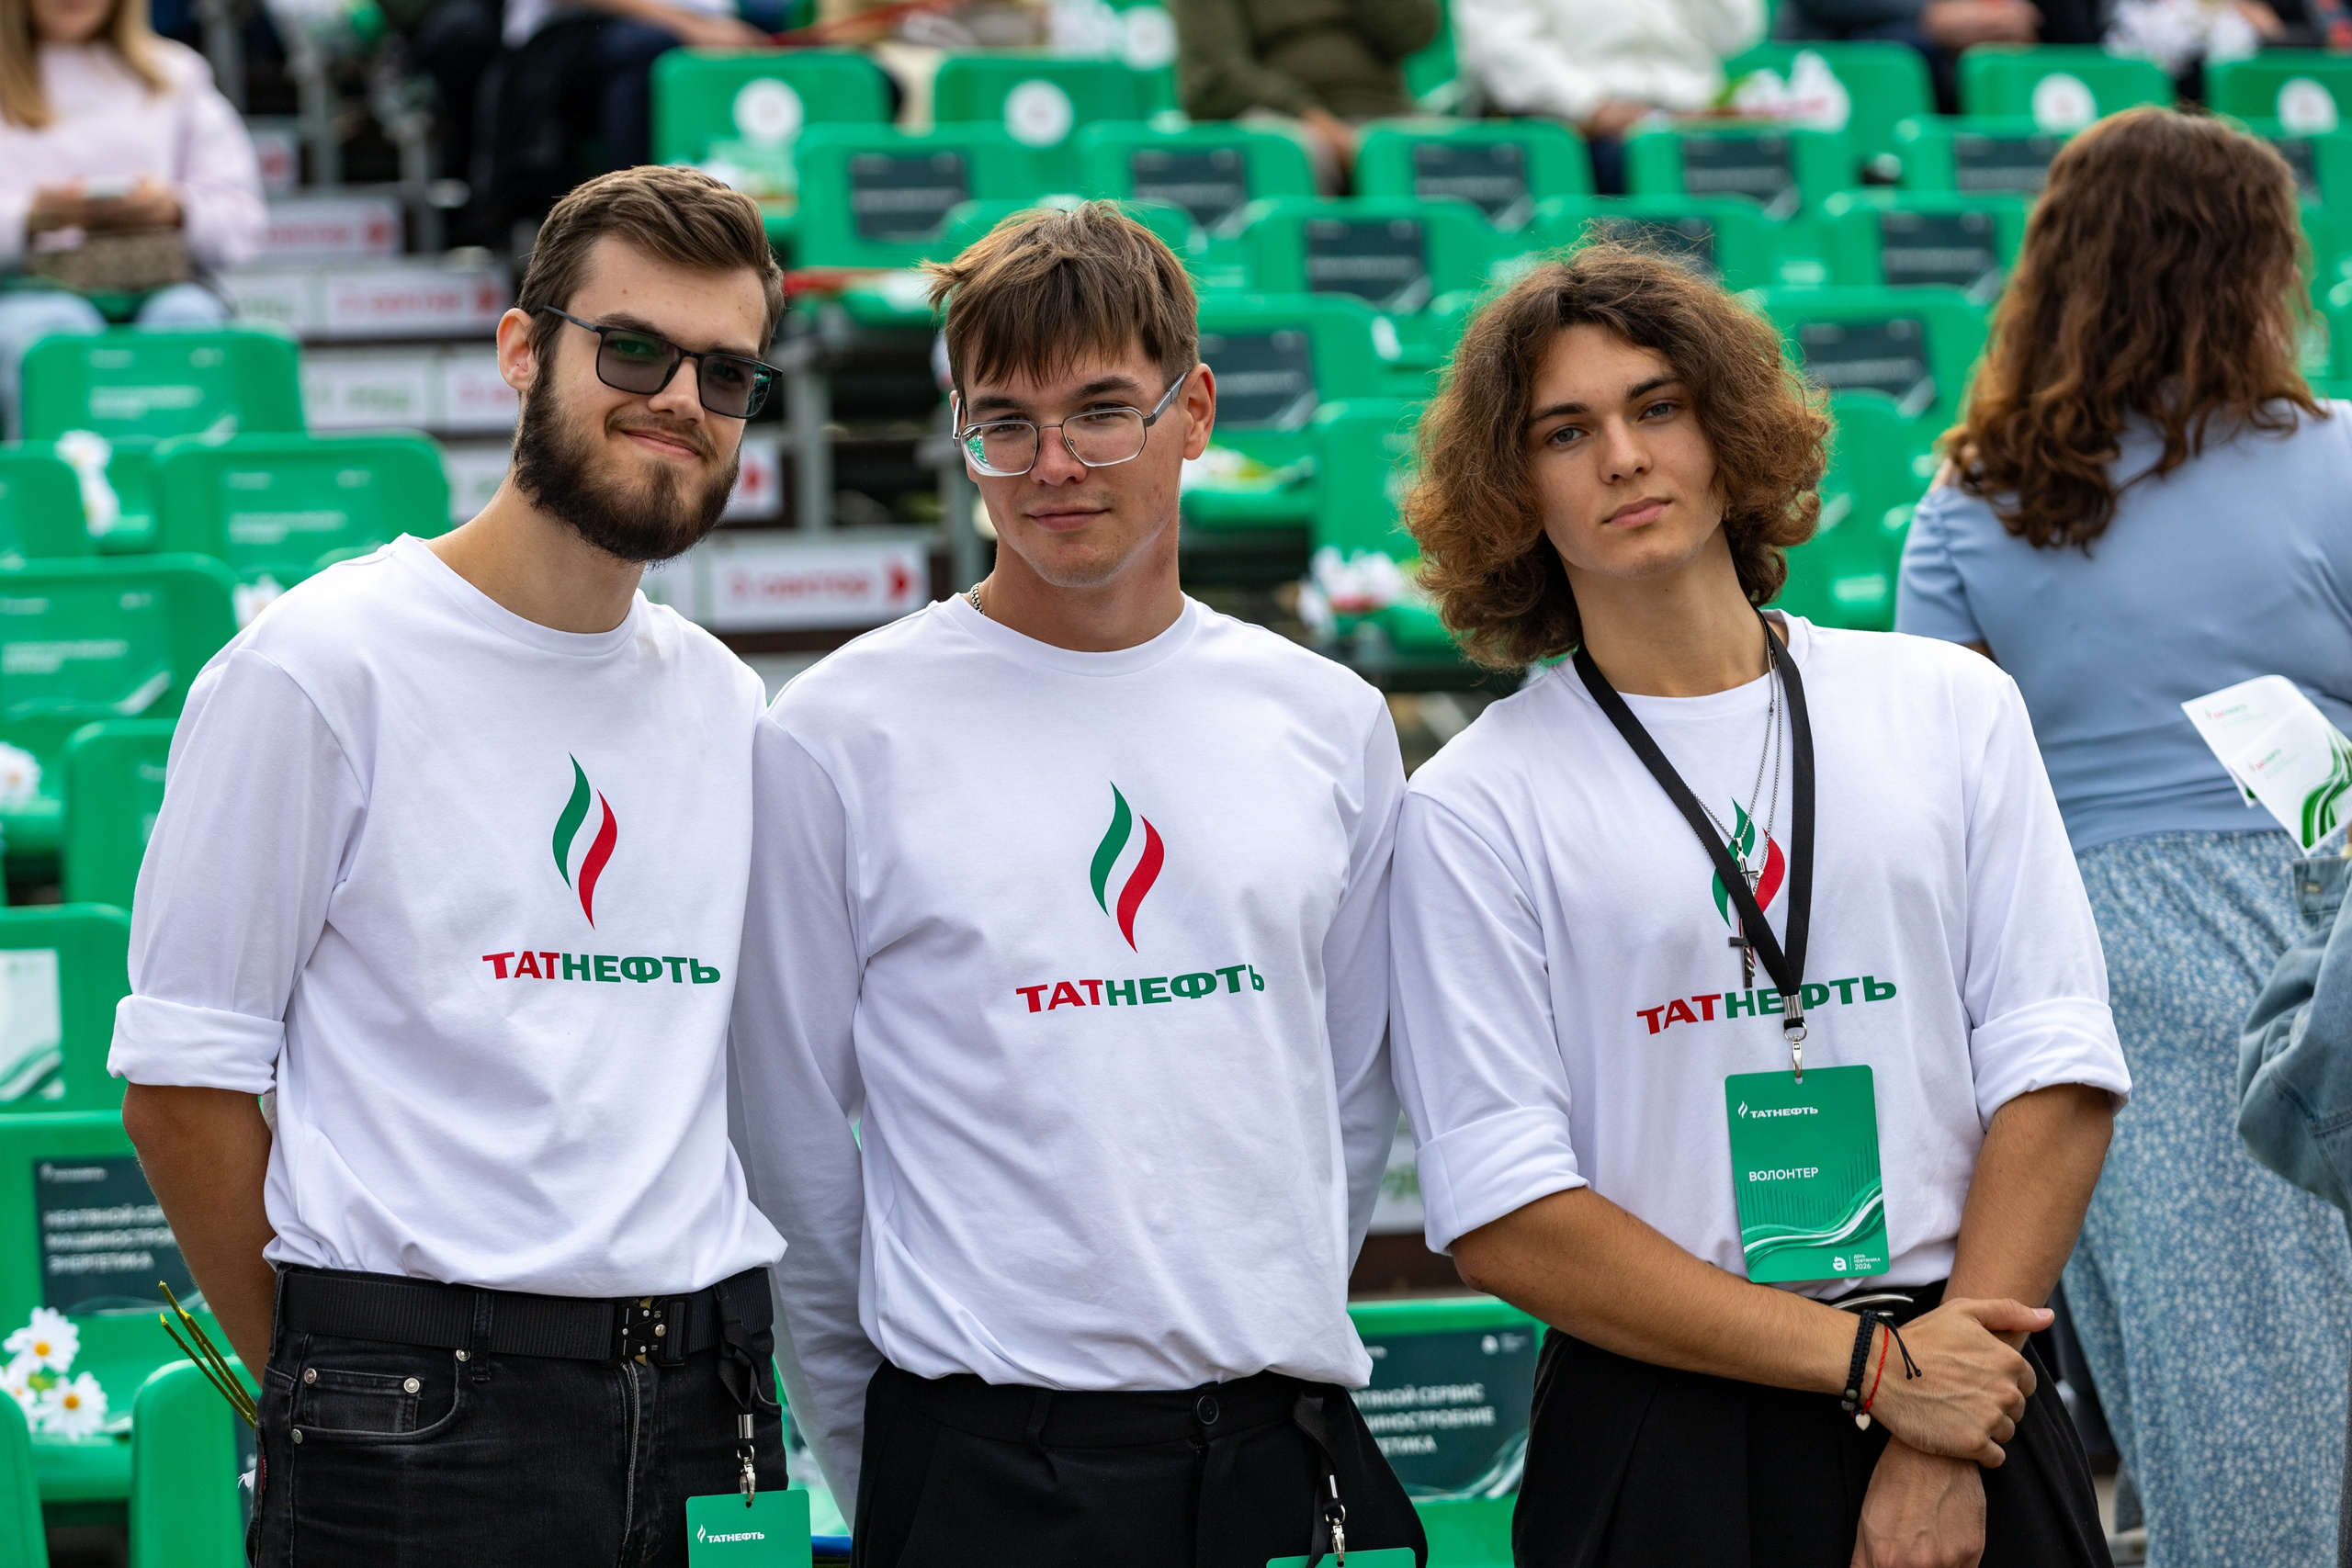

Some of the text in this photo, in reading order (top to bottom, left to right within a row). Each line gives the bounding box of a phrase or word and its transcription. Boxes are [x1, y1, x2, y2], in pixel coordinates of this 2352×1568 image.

[481, 951, 721, 984] ТАТНЕФТЬ
[1015, 964, 1265, 1013] ТАТНЕФТЬ
[1749, 1106, 1819, 1119] ТАТНЕФТЬ
[1748, 1167, 1819, 1182] ВОЛОНТЕР
[707, 1531, 765, 1543] ТАТНЕФТЬ
